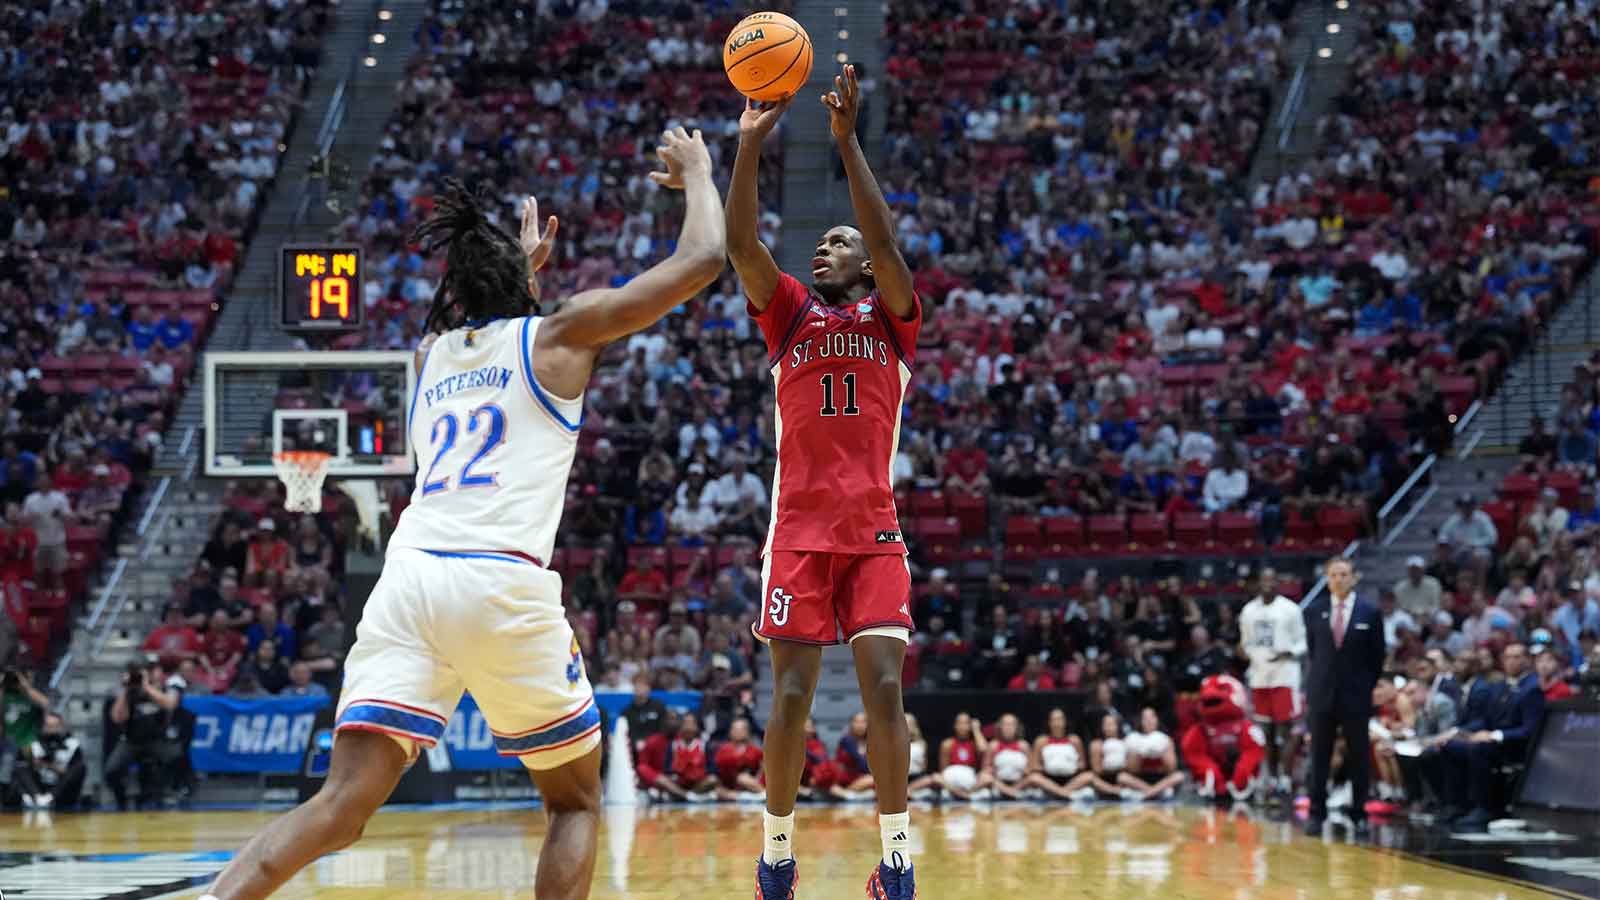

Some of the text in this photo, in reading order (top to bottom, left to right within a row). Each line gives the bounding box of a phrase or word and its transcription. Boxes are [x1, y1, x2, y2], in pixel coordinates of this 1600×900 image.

[728, 28, 765, 55] NCAA
[310, 277, 349, 319] 19
[791, 332, 888, 369] ST. JOHN'S
[424, 365, 514, 408] PETERSON
[819, 372, 860, 417] 11
[422, 402, 509, 497] 22
